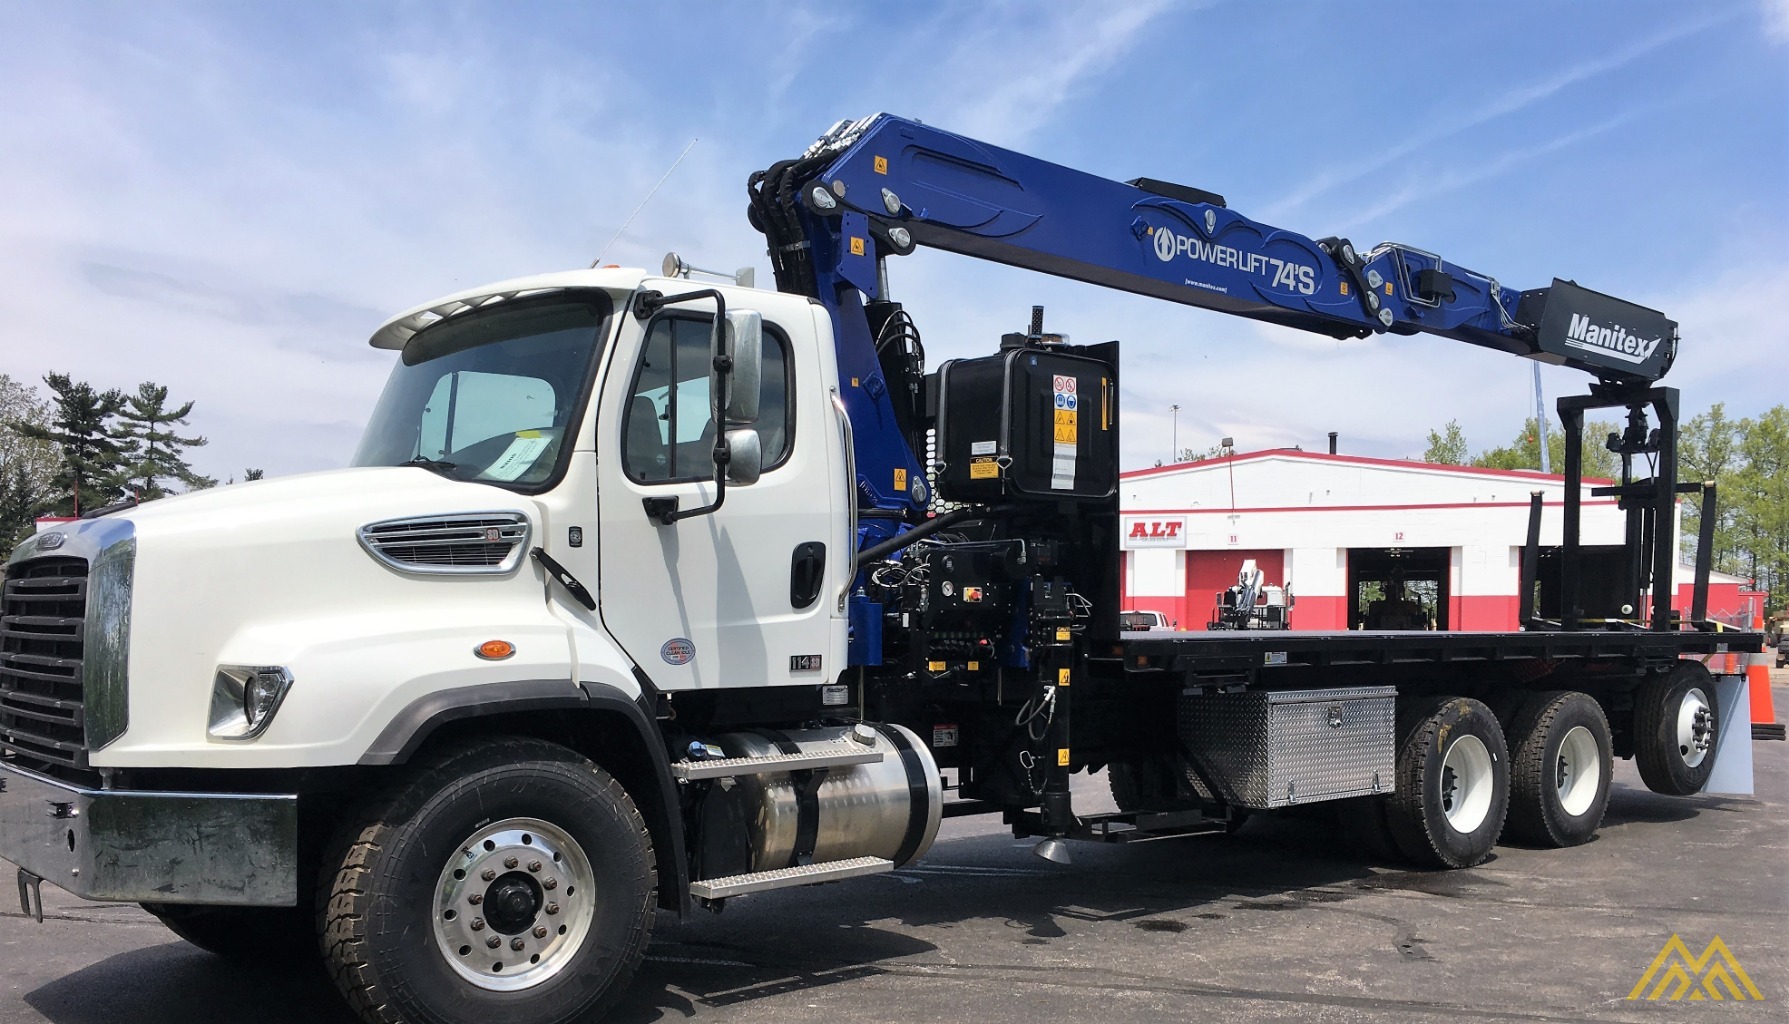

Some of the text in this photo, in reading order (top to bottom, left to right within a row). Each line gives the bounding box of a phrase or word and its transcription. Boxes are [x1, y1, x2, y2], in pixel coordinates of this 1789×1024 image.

[1269, 258, 1315, 295] 74'S
[1567, 313, 1650, 358] Manitex
[486, 528, 500, 540] SD
[1129, 521, 1182, 537] ALT
[1395, 532, 1403, 540] 12
[1230, 535, 1237, 543] 11
[792, 656, 809, 670] 114
